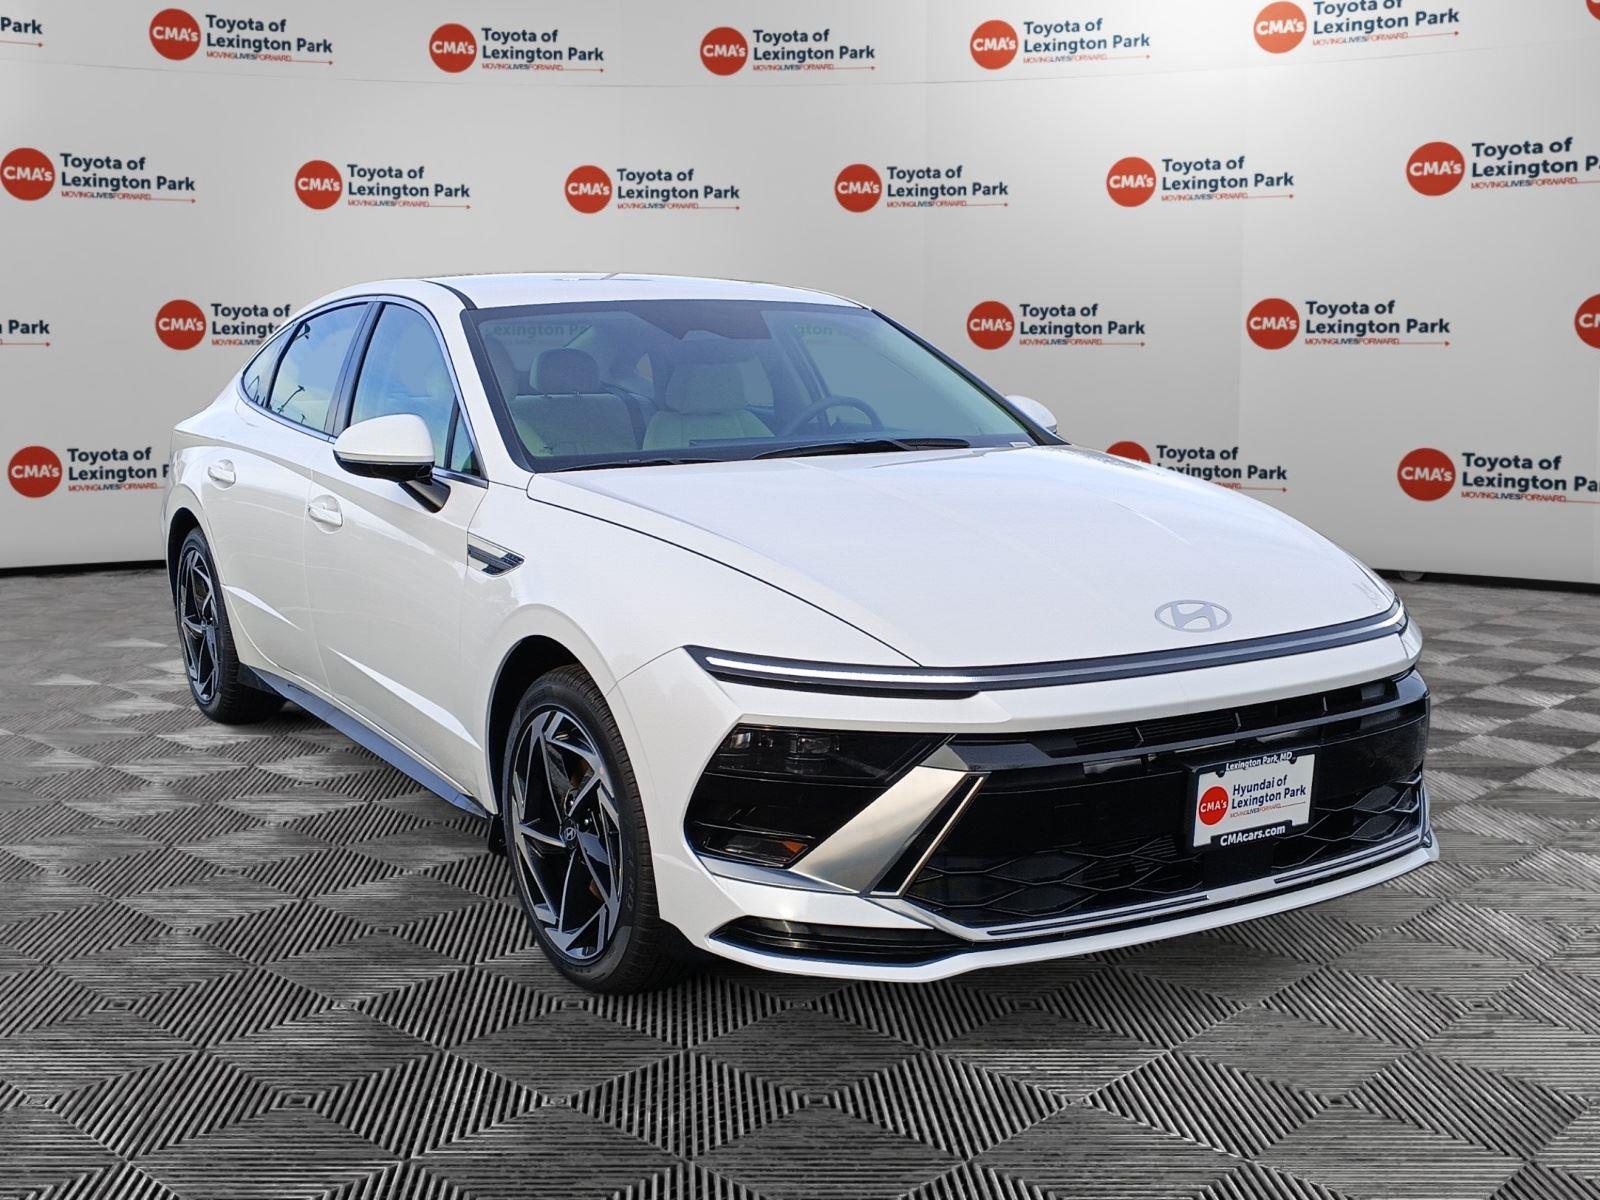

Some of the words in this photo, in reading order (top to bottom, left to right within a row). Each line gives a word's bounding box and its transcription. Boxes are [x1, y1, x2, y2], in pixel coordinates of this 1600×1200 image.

[1314, 0, 1377, 17] Toyota
[1383, 0, 1403, 9] of
[1, 17, 42, 34] Park
[206, 15, 264, 33] Toyota
[269, 19, 286, 32] of
[1024, 21, 1079, 37] Toyota
[1085, 18, 1102, 31] of
[1256, 19, 1304, 35] CMA's
[1314, 16, 1408, 34] Lexington
[1416, 9, 1459, 25] Park
[152, 26, 198, 42] CMA's
[482, 28, 536, 44] Toyota
[541, 30, 557, 42] of
[753, 30, 808, 46] Toyota
[813, 29, 829, 41] of
[207, 33, 291, 53] Lexington
[297, 38, 332, 52] Park
[432, 41, 474, 54] CMA's
[703, 44, 746, 57] CMA's
[973, 37, 1016, 51] CMA's
[1025, 39, 1106, 54] Lexington
[1113, 34, 1149, 48] Park
[483, 46, 562, 63] Lexington
[569, 47, 603, 60] Park
[754, 45, 833, 63] Lexington
[840, 46, 874, 58] Park
[1472, 141, 1543, 160] Toyota
[1550, 137, 1572, 152] of
[60, 154, 122, 172] Toyota
[127, 157, 145, 170] of
[1162, 159, 1220, 175] Toyota
[1226, 156, 1244, 169] of
[1410, 160, 1462, 176] CMA's
[1473, 160, 1577, 178] Lexington
[3, 166, 52, 181] CMA's
[62, 172, 150, 191] Lexington
[157, 176, 194, 190] Park
[347, 165, 402, 181] Toyota
[408, 167, 424, 178] of
[617, 169, 672, 184] Toyota
[677, 169, 693, 181] of
[887, 167, 940, 182] Toyota
[946, 166, 962, 178] of
[1109, 174, 1153, 188] CMA's
[298, 178, 340, 191] CMA's
[349, 182, 428, 199] Lexington
[435, 184, 469, 197] Park
[568, 183, 610, 195] CMA's
[837, 181, 879, 194] CMA's
[888, 184, 966, 200] Lexington
[973, 182, 1008, 195] Park
[1163, 176, 1248, 192] Lexington
[1255, 173, 1293, 186] Park
[618, 186, 698, 202] Lexington
[704, 186, 739, 198] Park
[211, 304, 268, 320] Toyota
[273, 304, 290, 317] of
[1020, 304, 1075, 320] Toyota
[1080, 304, 1097, 316] of
[1306, 301, 1369, 318] Toyota
[1375, 300, 1395, 314] of
[9, 320, 49, 334] Park
[159, 318, 203, 331] CMA's
[213, 321, 280, 338] Lexingt
[494, 325, 564, 339] exington
[970, 319, 1012, 331] CMA's
[1021, 322, 1102, 338] Lexington
[1108, 321, 1144, 334] Park
[1250, 317, 1297, 330] CMA's
[1306, 320, 1399, 337] Lexington
[1407, 319, 1449, 333] Park
[67, 449, 128, 465] Toyota
[133, 447, 151, 460] of
[1157, 445, 1215, 462] Toyota
[1220, 447, 1238, 460] of
[1462, 453, 1532, 471] Toyota
[1539, 456, 1561, 470] of
[11, 464, 60, 478] CMA's
[69, 467, 156, 482] Lexington
[1157, 463, 1242, 481] xington
[1248, 465, 1286, 479] Park
[1401, 467, 1452, 481] CMA's
[1463, 472, 1566, 492] Lexington
[1574, 476, 1600, 491] Pa
[1226, 759, 1261, 770] Lexington
[1280, 752, 1292, 760] MD
[1233, 778, 1274, 797] Hyundai
[1276, 774, 1288, 787] of
[1231, 791, 1281, 810] Lexington
[1284, 785, 1306, 800] Park
[1200, 800, 1227, 813] CMA's
[1221, 825, 1285, 846] CMAcars.com
